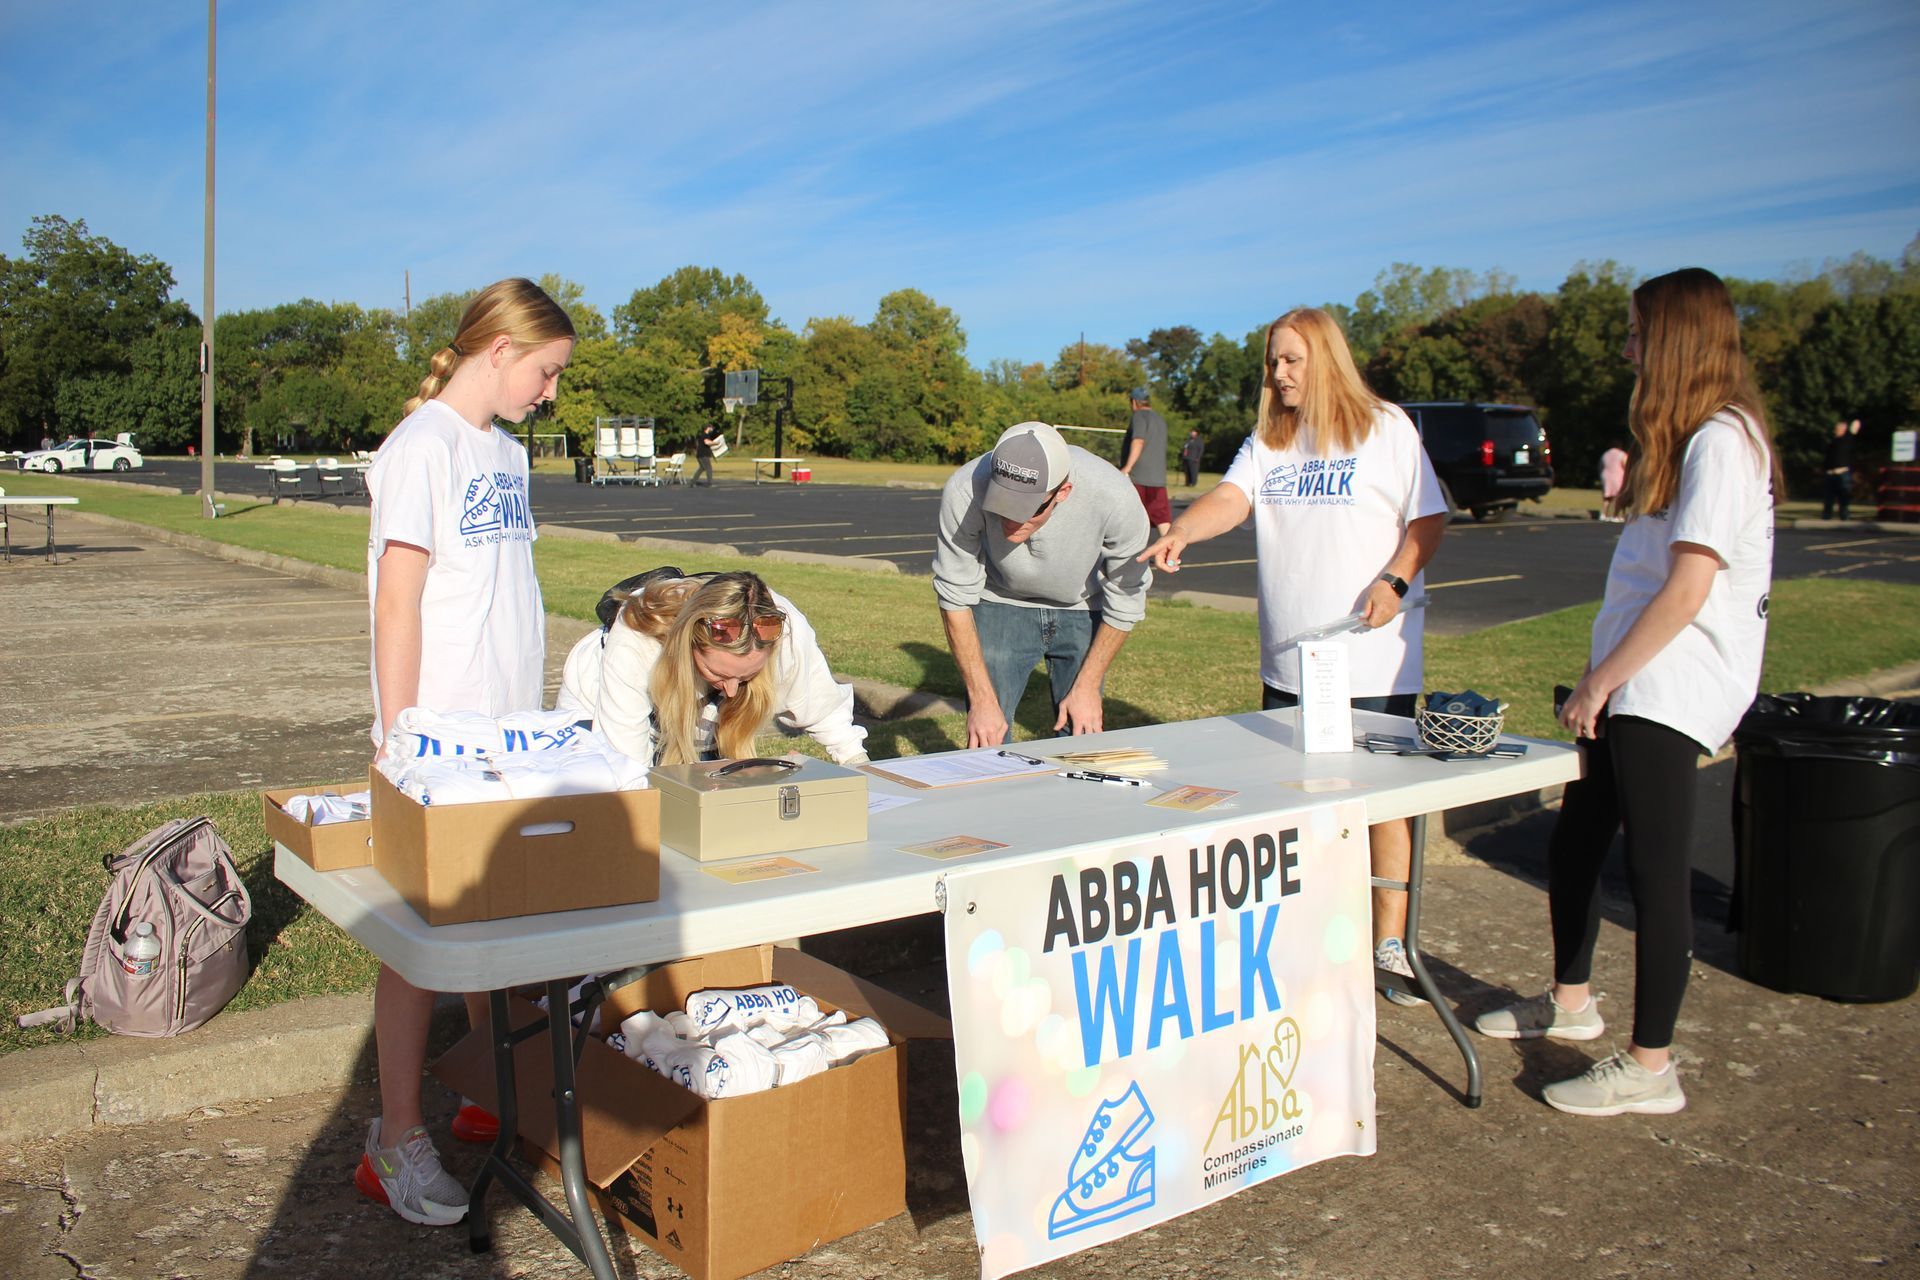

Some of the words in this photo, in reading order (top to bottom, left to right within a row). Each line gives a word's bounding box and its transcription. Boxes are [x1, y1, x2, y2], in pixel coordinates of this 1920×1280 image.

[994, 467, 1037, 485] ARMOUR
[996, 458, 1039, 479] UNDER
[1300, 460, 1325, 473] ABBA
[1328, 458, 1357, 470] HOPE
[493, 472, 515, 490] ABBA
[1298, 471, 1354, 496] WALK
[499, 492, 528, 529] WAL
[465, 537, 485, 549] ASK
[486, 533, 499, 544] ME
[1043, 855, 1177, 953] ABBA
[1190, 827, 1301, 919] HOPE
[1071, 903, 1281, 1068] WALK
[735, 994, 773, 1011] ABBA
[1203, 1123, 1304, 1172] Compassionate
[1204, 1154, 1267, 1190] Ministries
